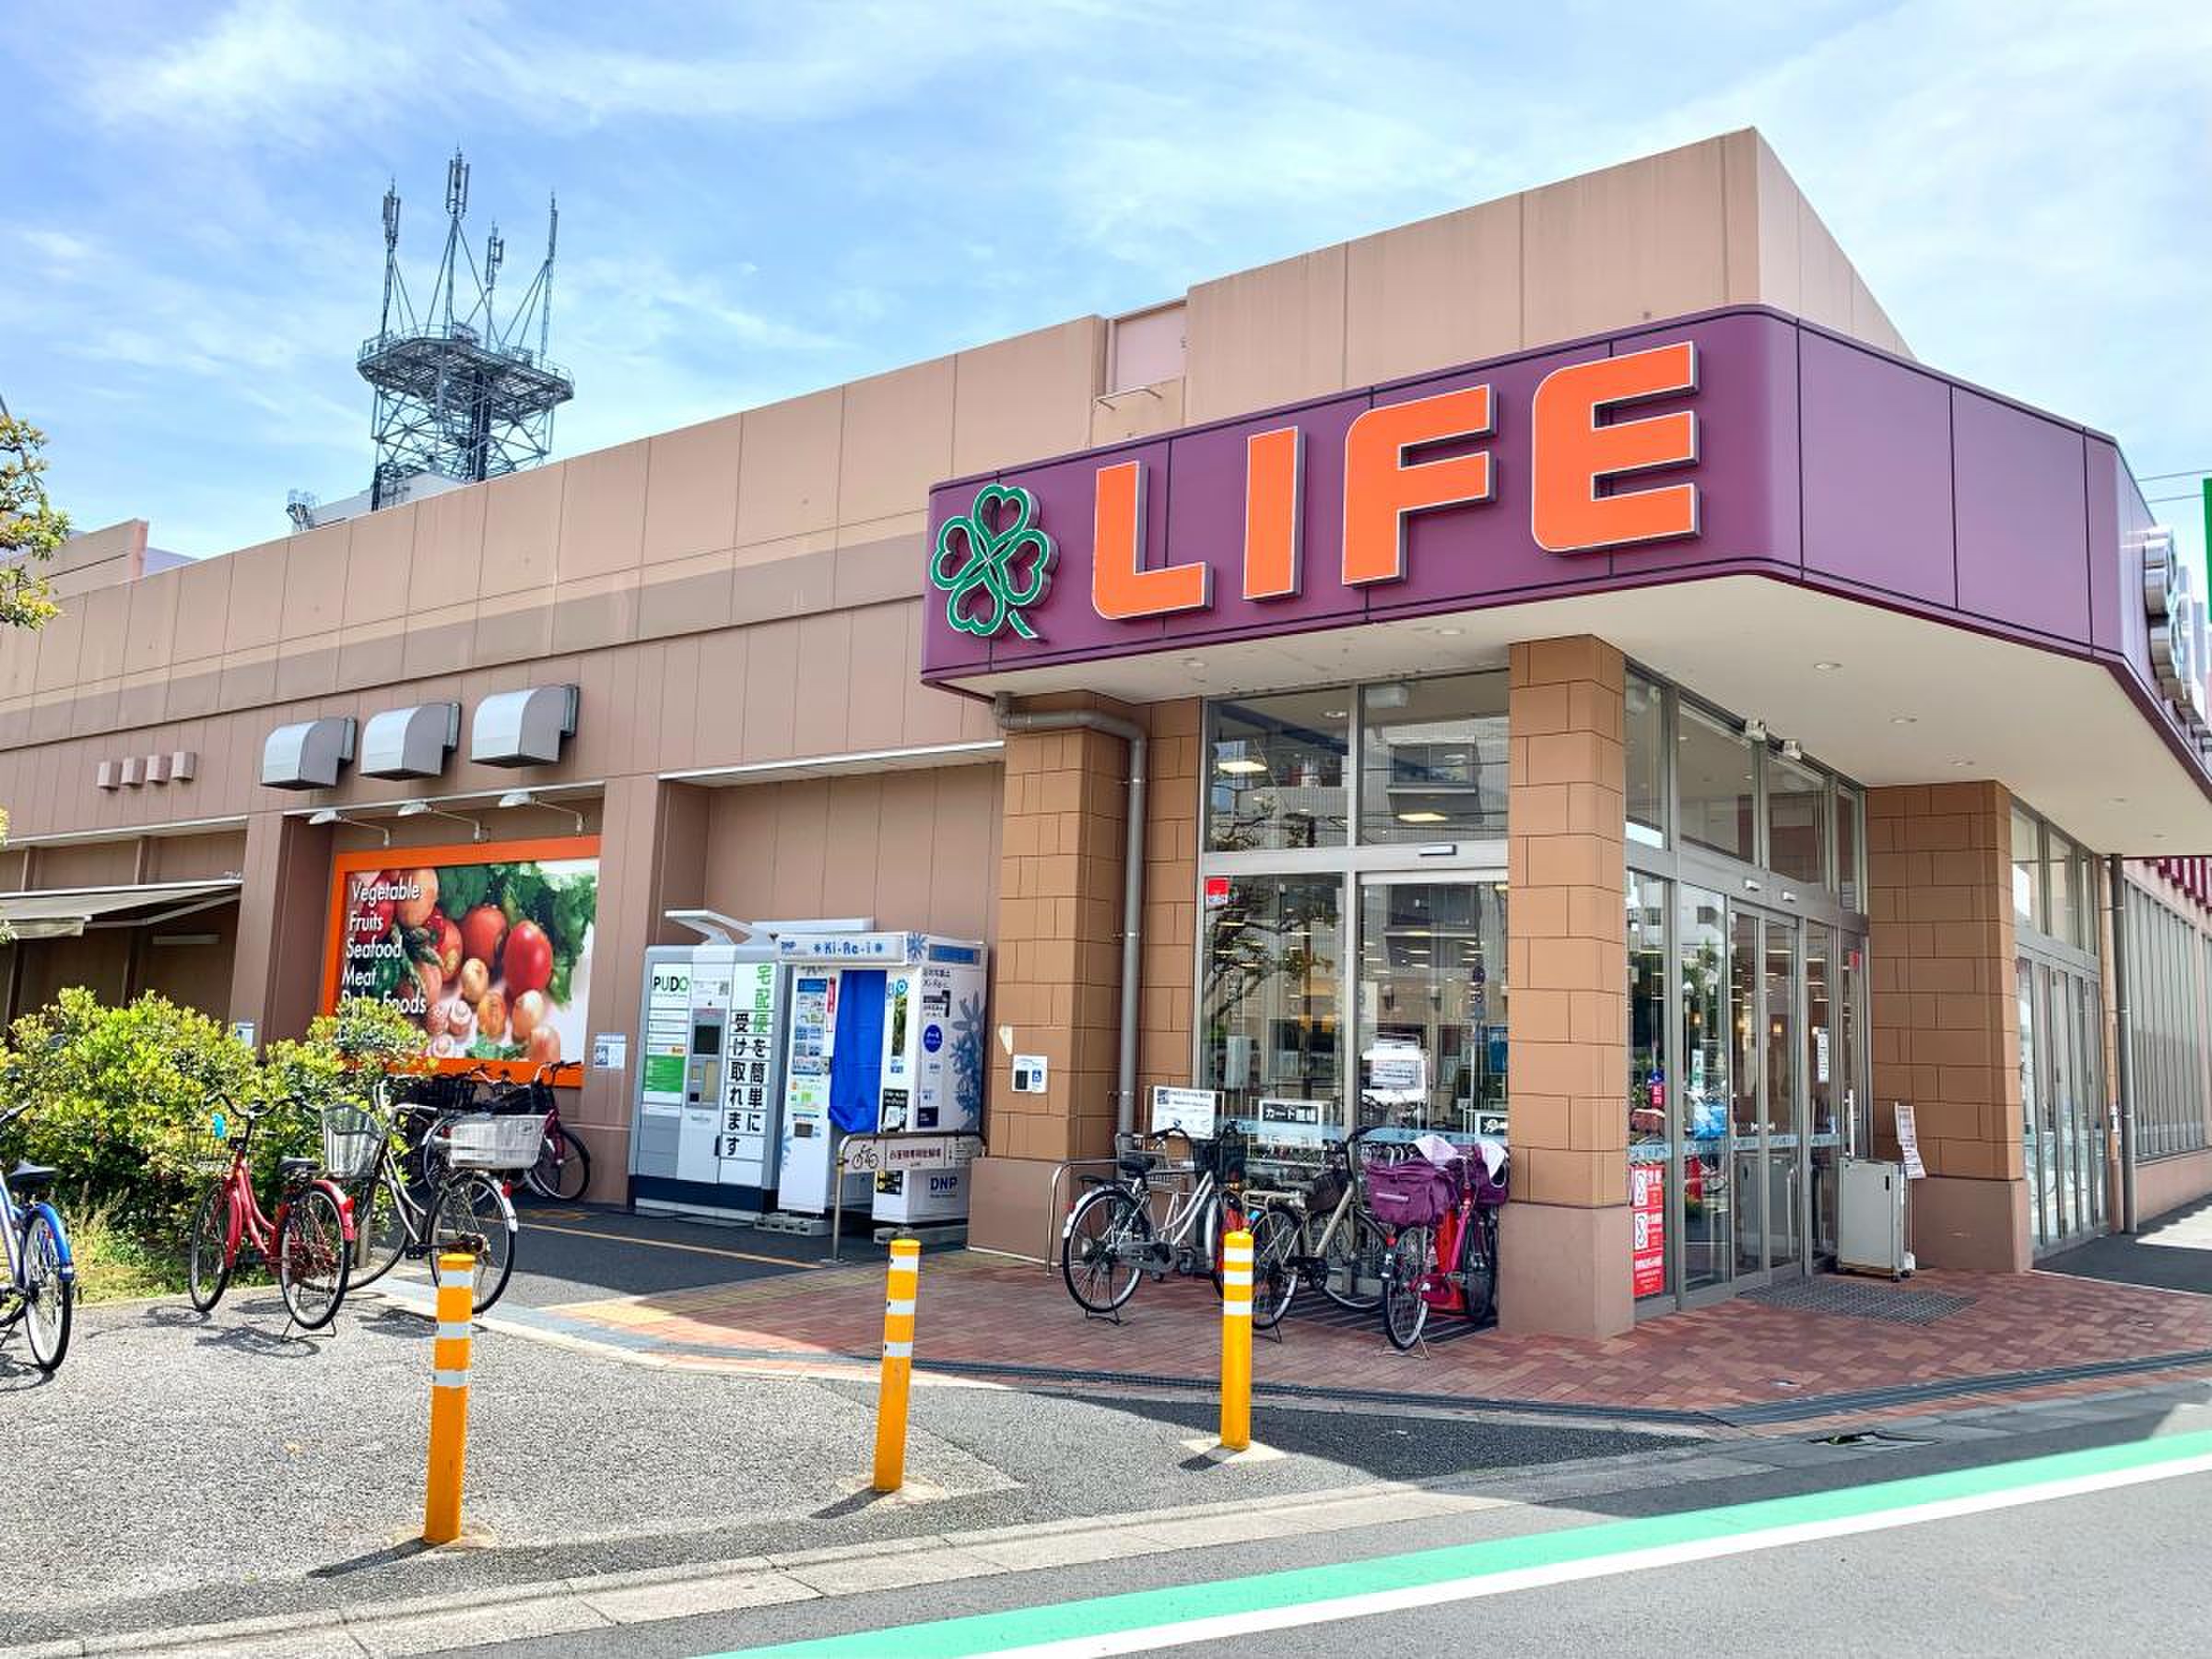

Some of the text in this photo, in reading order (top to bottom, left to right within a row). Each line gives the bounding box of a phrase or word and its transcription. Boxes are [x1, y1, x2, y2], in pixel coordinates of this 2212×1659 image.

[1092, 340, 1700, 619] LIFE
[352, 876, 420, 906] Vegetable
[348, 909, 384, 932] Fruits
[346, 935, 403, 959] Seafood
[341, 966, 377, 987] Meat
[653, 975, 689, 993] PUDO
[747, 964, 772, 1133] 宅配便を簡単に
[727, 1012, 749, 1157] 受け取れます
[930, 1176, 959, 1191] DNP
